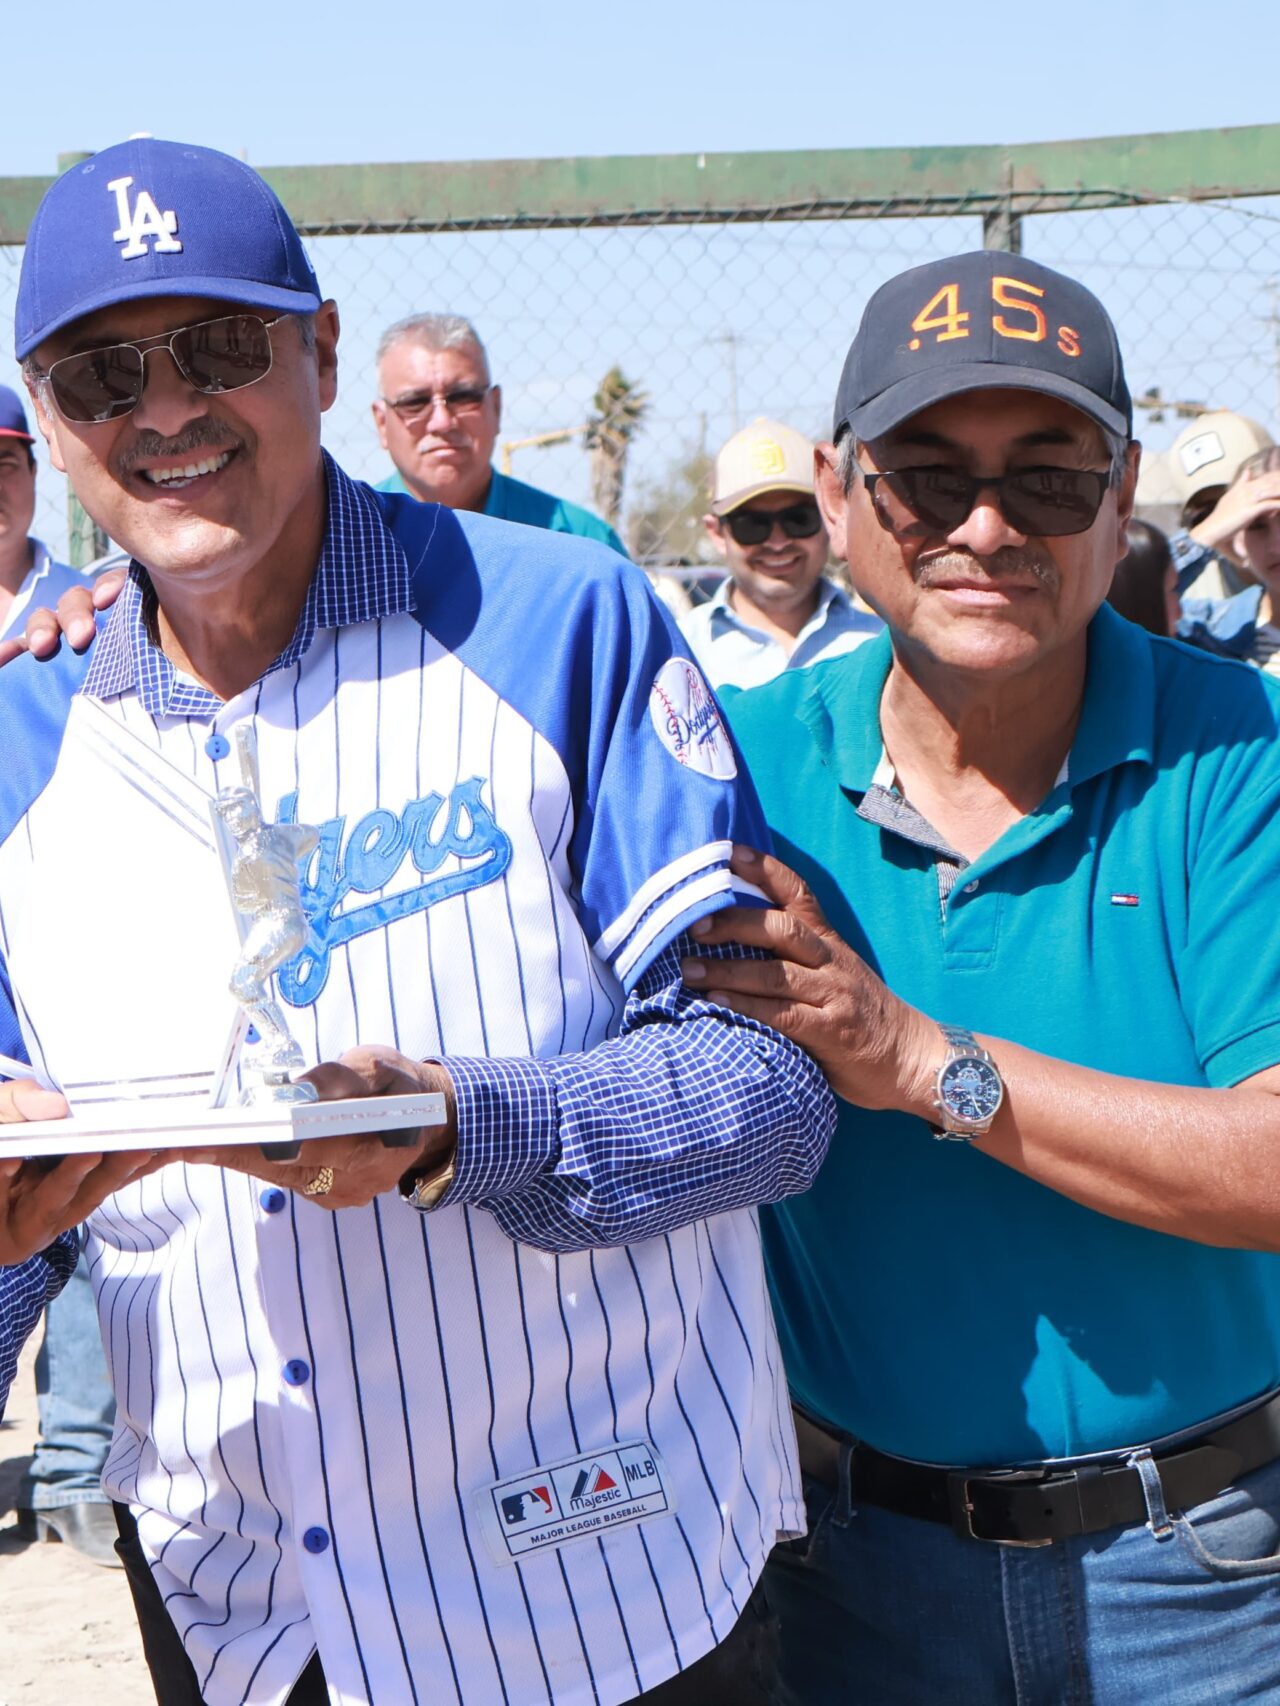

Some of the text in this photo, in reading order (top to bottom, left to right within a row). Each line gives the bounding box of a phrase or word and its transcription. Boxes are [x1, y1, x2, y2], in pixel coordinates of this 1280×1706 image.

[107, 176, 182, 260] LA
[273, 775, 513, 1008] gers
[625, 1460, 656, 1482] MLB
[570, 1488, 622, 1512] Majestic
[530, 1504, 647, 1544] MAJOR LEAGUE BASEBALL
